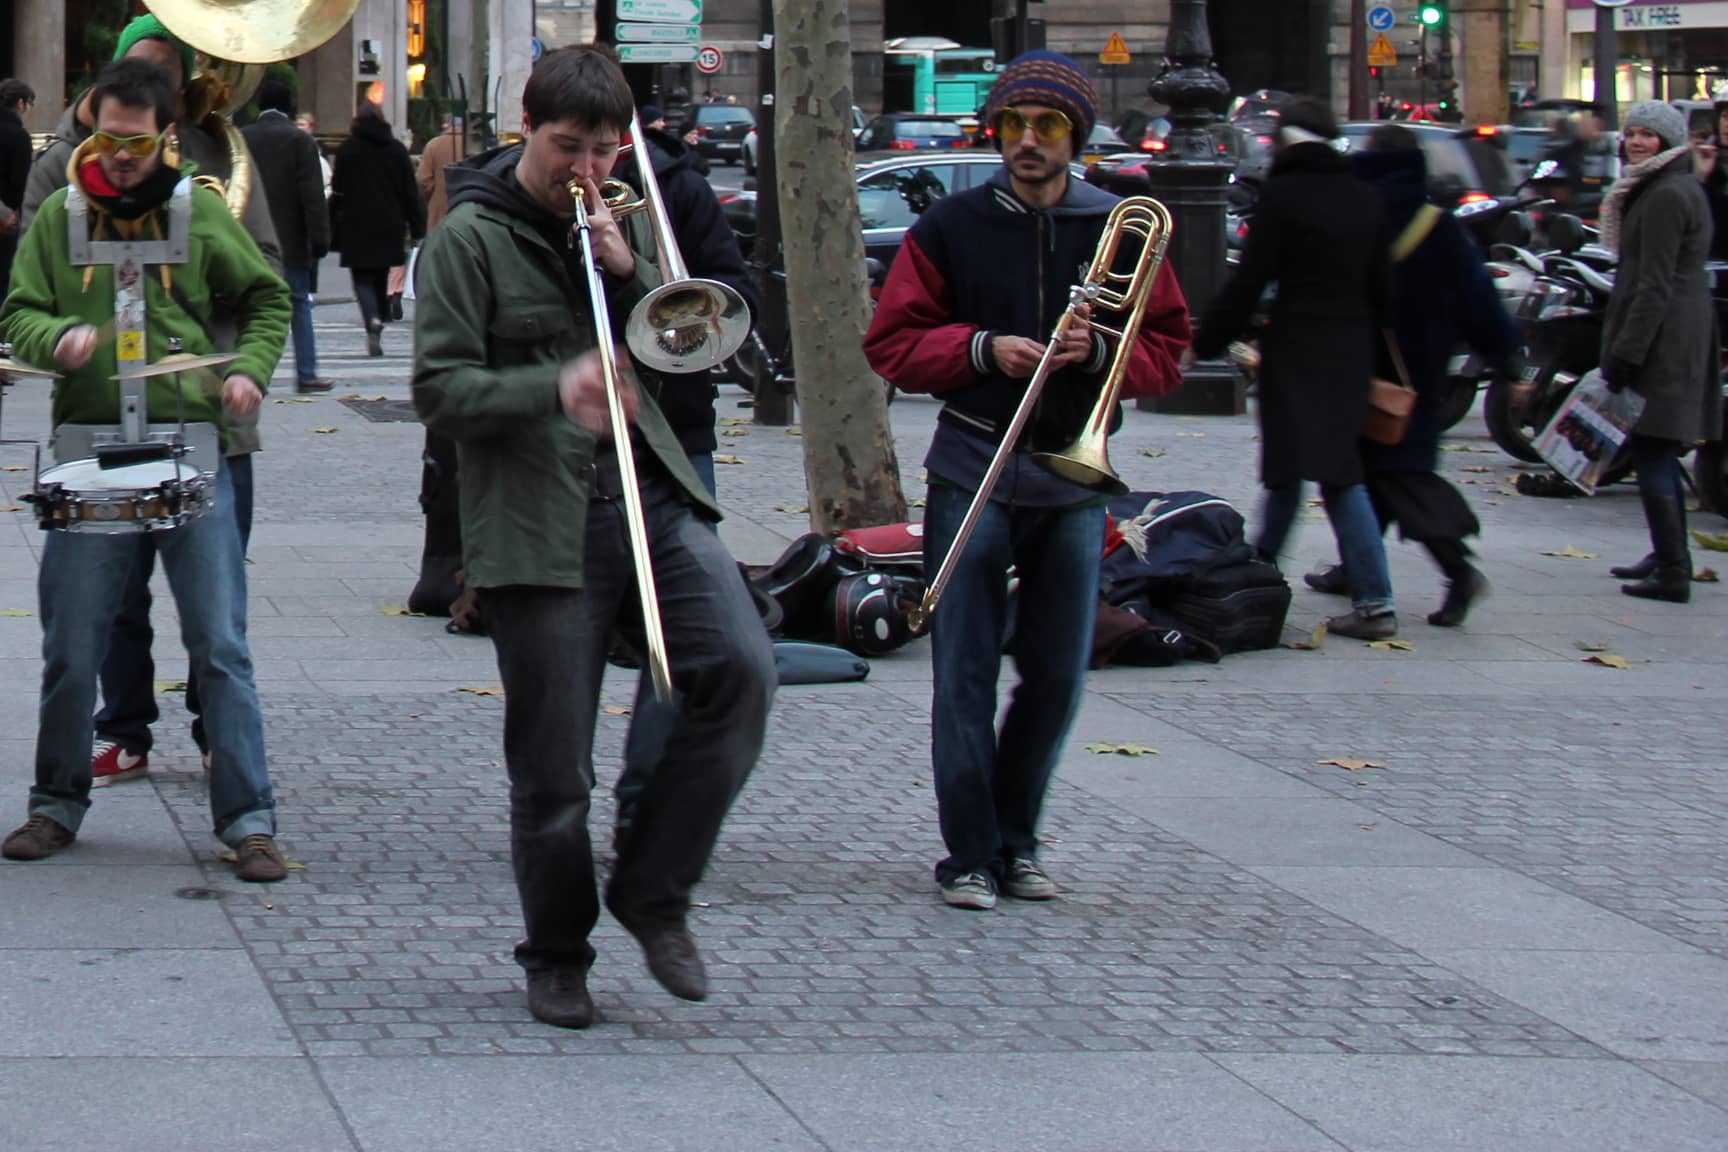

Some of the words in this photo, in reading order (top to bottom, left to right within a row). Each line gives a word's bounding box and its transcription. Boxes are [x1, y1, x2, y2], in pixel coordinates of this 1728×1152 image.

[1622, 8, 1645, 27] TAX
[1649, 6, 1681, 26] FREE
[702, 53, 716, 65] 15
